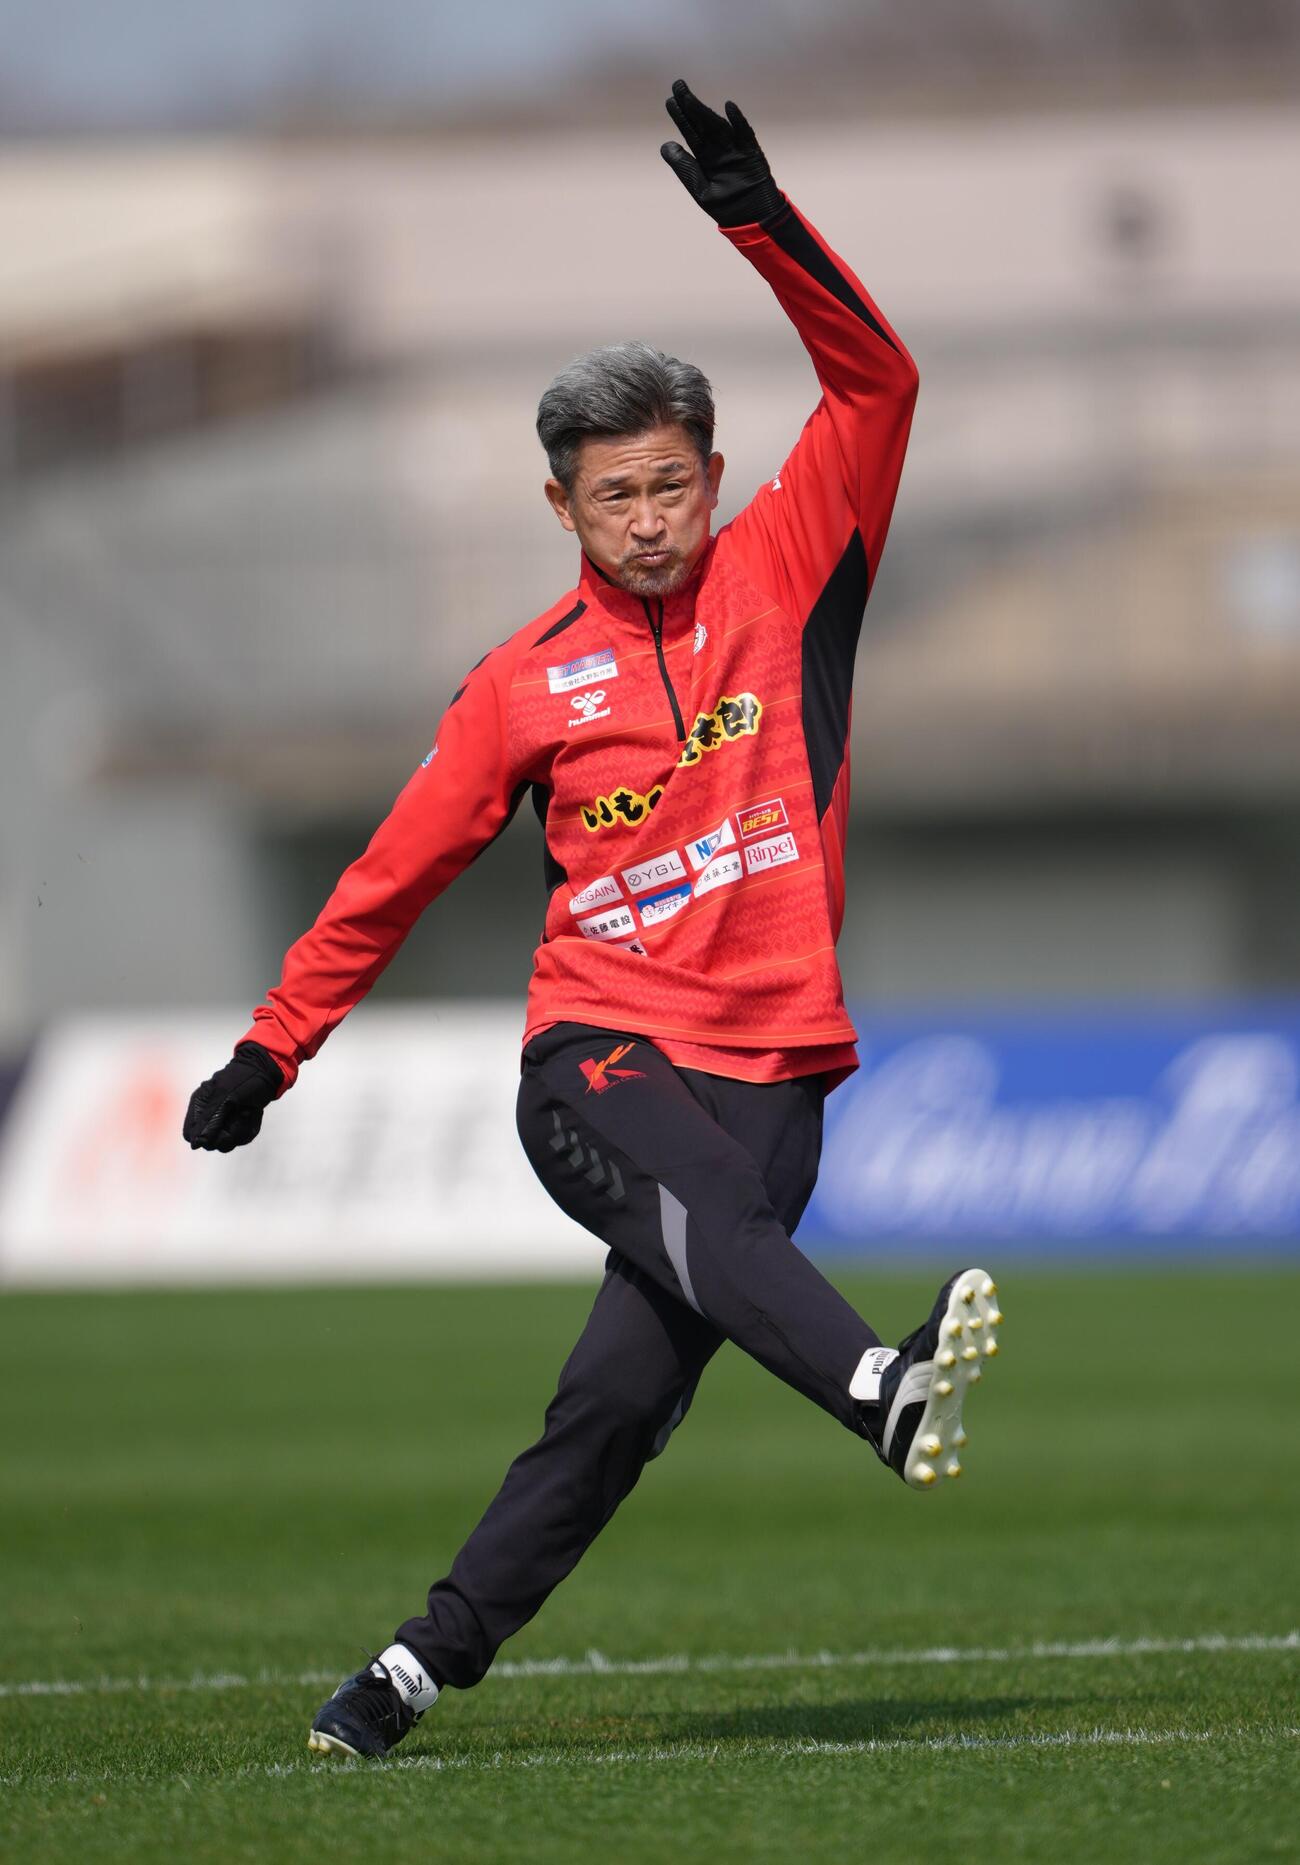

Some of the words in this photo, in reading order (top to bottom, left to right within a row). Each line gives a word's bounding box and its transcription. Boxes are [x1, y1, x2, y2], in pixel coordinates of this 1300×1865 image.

[568, 706, 611, 728] hummel
[742, 810, 782, 833] BEST
[642, 861, 681, 880] YGL
[590, 914, 631, 936] 佐藤電設
[390, 1664, 418, 1696] PUMA
